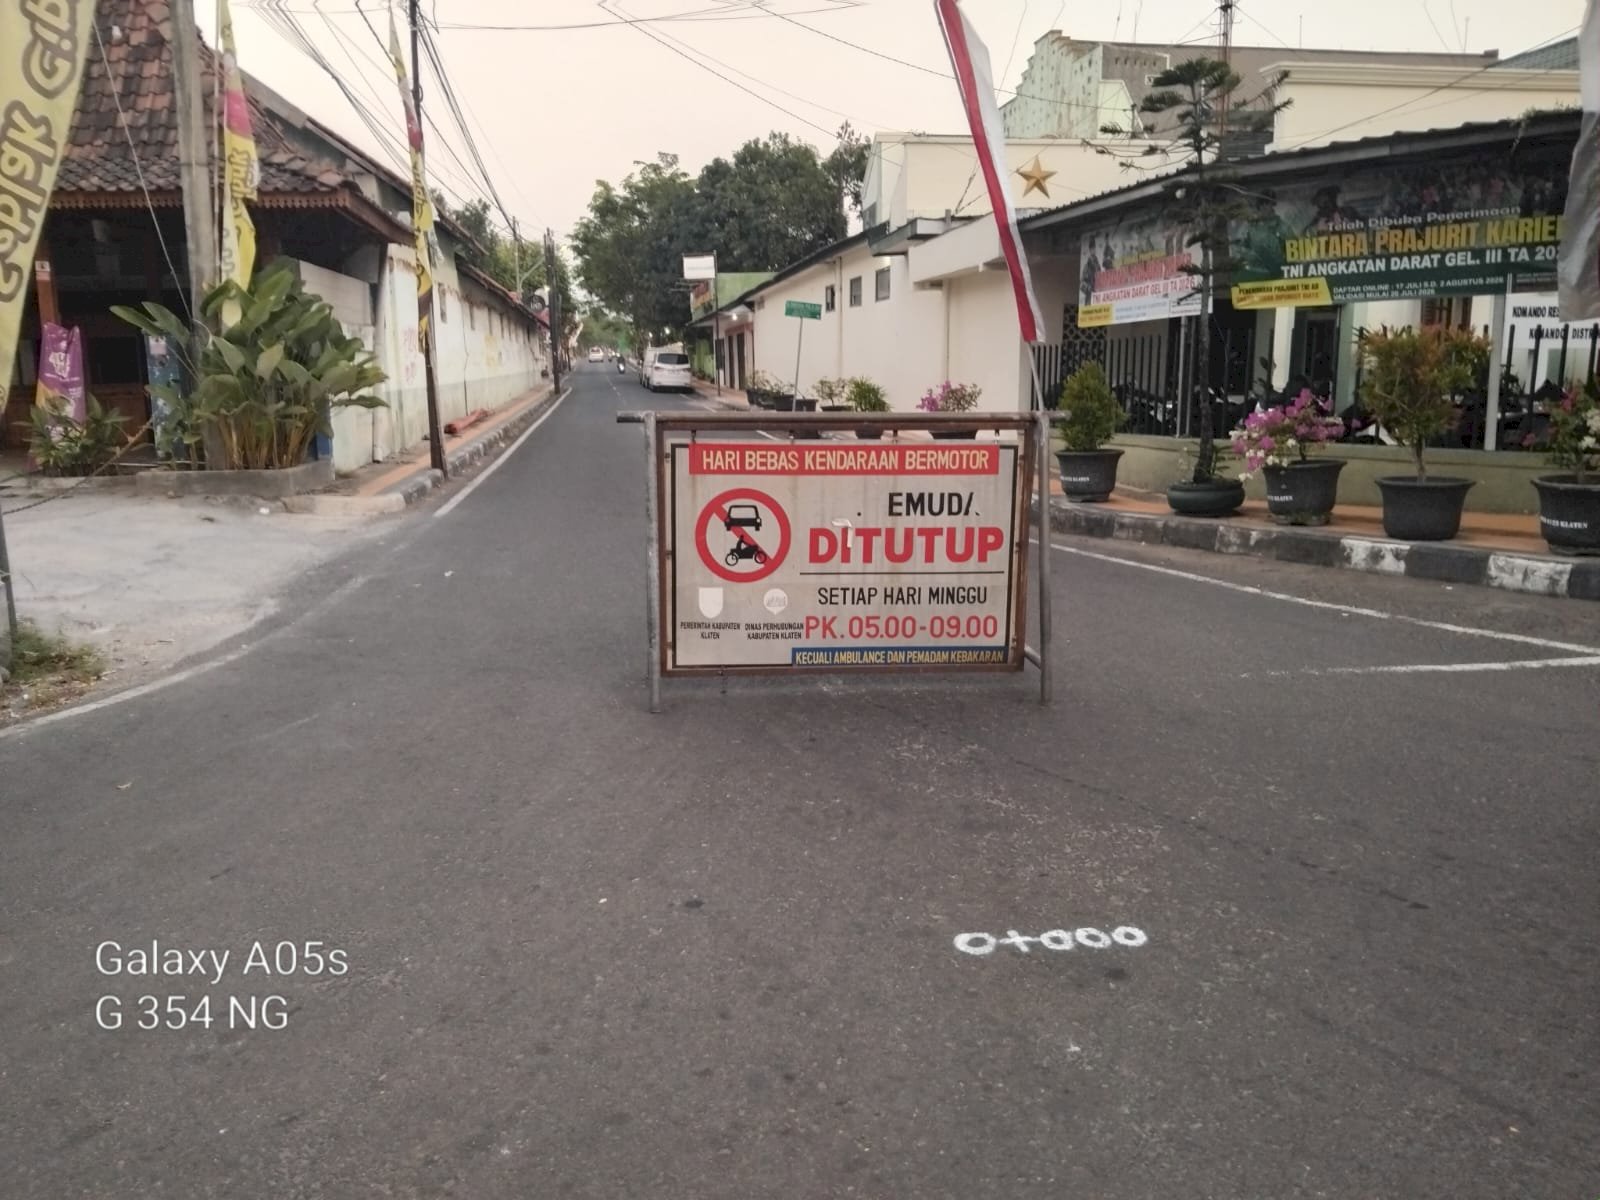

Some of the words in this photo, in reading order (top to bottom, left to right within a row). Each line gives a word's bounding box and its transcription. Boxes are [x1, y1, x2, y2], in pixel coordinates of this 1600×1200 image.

[1328, 219, 1364, 231] Telah
[1368, 213, 1422, 229] Dibuka
[1427, 205, 1521, 223] Penerimaan
[1285, 231, 1368, 263] BINTARA
[1375, 222, 1480, 255] PRAJURIT
[1281, 265, 1303, 279] TNI
[1307, 258, 1386, 277] ANGKATAN
[1390, 254, 1441, 270] DARAT
[1445, 251, 1480, 266] GEL.
[1486, 249, 1501, 264] III
[1508, 248, 1530, 262] TA
[1446, 278, 1484, 287] AGUSTUS
[1512, 306, 1546, 318] KOMANDO
[703, 449, 740, 470] HARI
[744, 449, 799, 470] BEBAS
[804, 449, 899, 470] KENDARAAN
[904, 449, 989, 470] BERMOTOR
[808, 526, 1004, 564] DITUTUP
[817, 586, 878, 606] SETIAP
[884, 586, 922, 605] HARI
[928, 586, 988, 605] MINGGU
[680, 621, 711, 630] PEMERINTAH
[712, 621, 741, 630] KABUPATEN
[744, 622, 762, 631] DINAS
[763, 622, 804, 631] PERHUBUNGAN
[700, 631, 720, 640] KLATEN
[747, 631, 780, 640] KABUPATEN
[780, 631, 802, 640] KLATEN
[795, 651, 832, 665] KECUALI
[833, 651, 887, 665] AMBULANCE
[887, 651, 905, 664] DAN
[906, 650, 949, 664] PEMADAM
[950, 650, 1004, 664] KEBAKARAN
[953, 925, 1148, 956] 0+000
